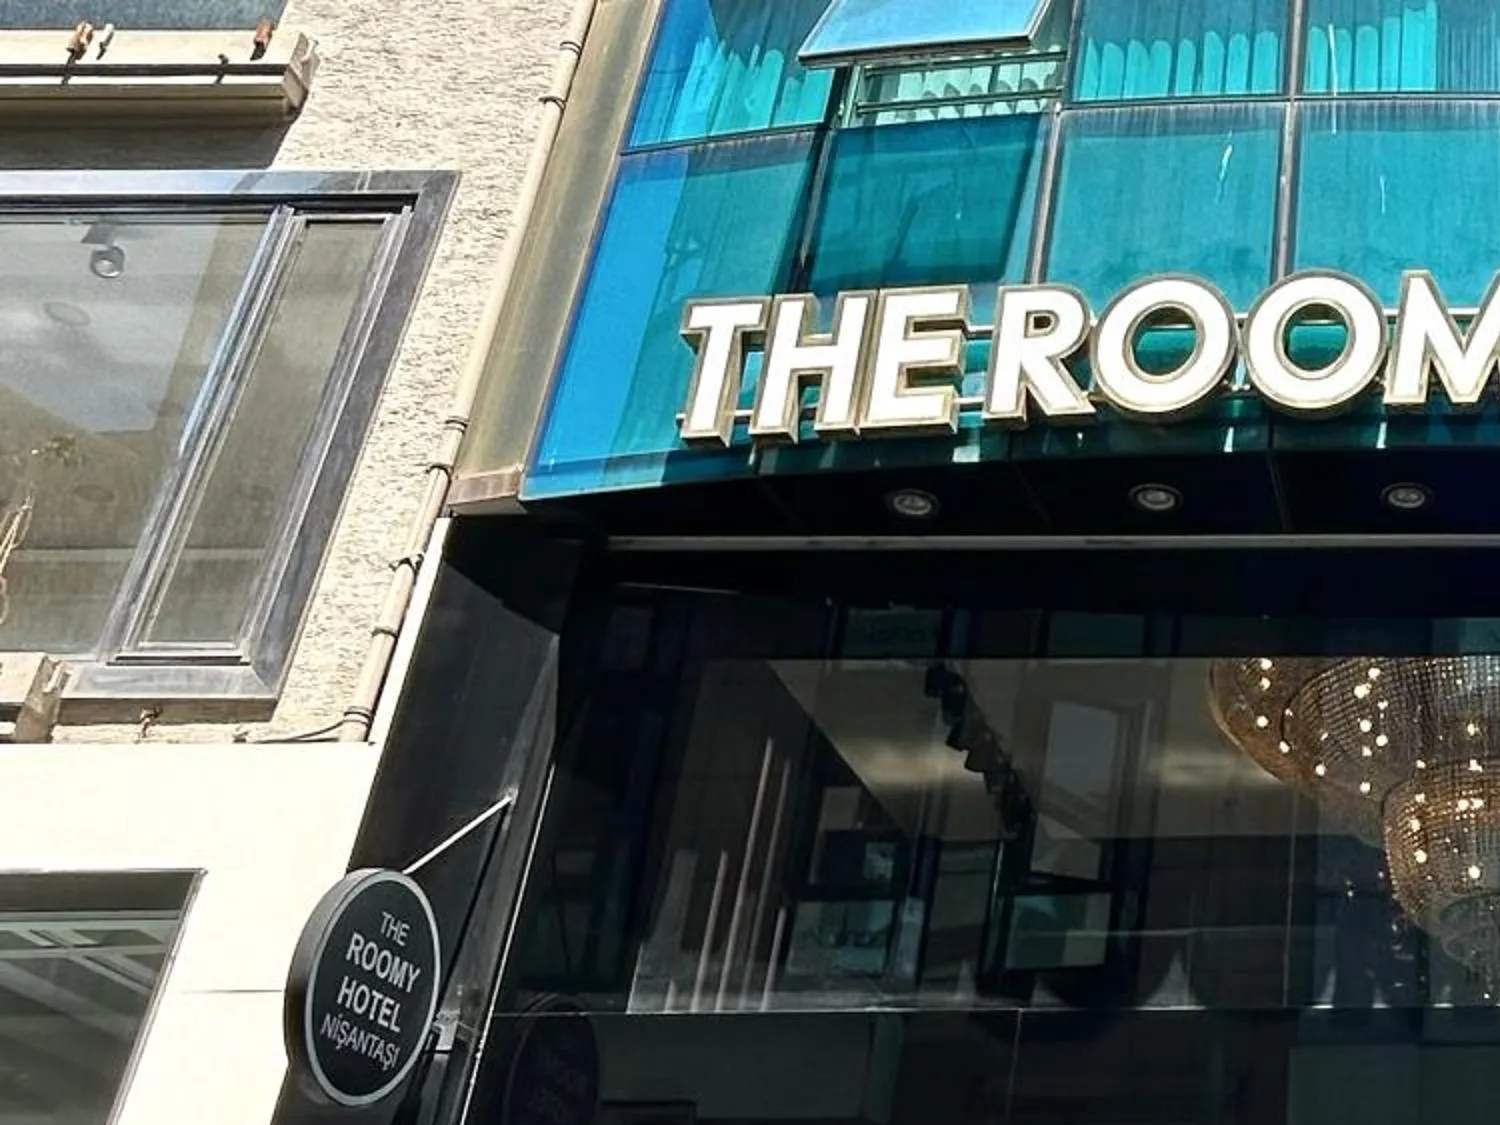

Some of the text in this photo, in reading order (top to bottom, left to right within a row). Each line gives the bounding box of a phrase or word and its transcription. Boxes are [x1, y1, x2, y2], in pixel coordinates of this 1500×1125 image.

[679, 283, 971, 448] THE
[379, 910, 412, 947] THE
[345, 932, 421, 993] ROOMY
[336, 975, 401, 1034] HOTEL
[319, 1012, 400, 1072] NİŞANTAŞI
